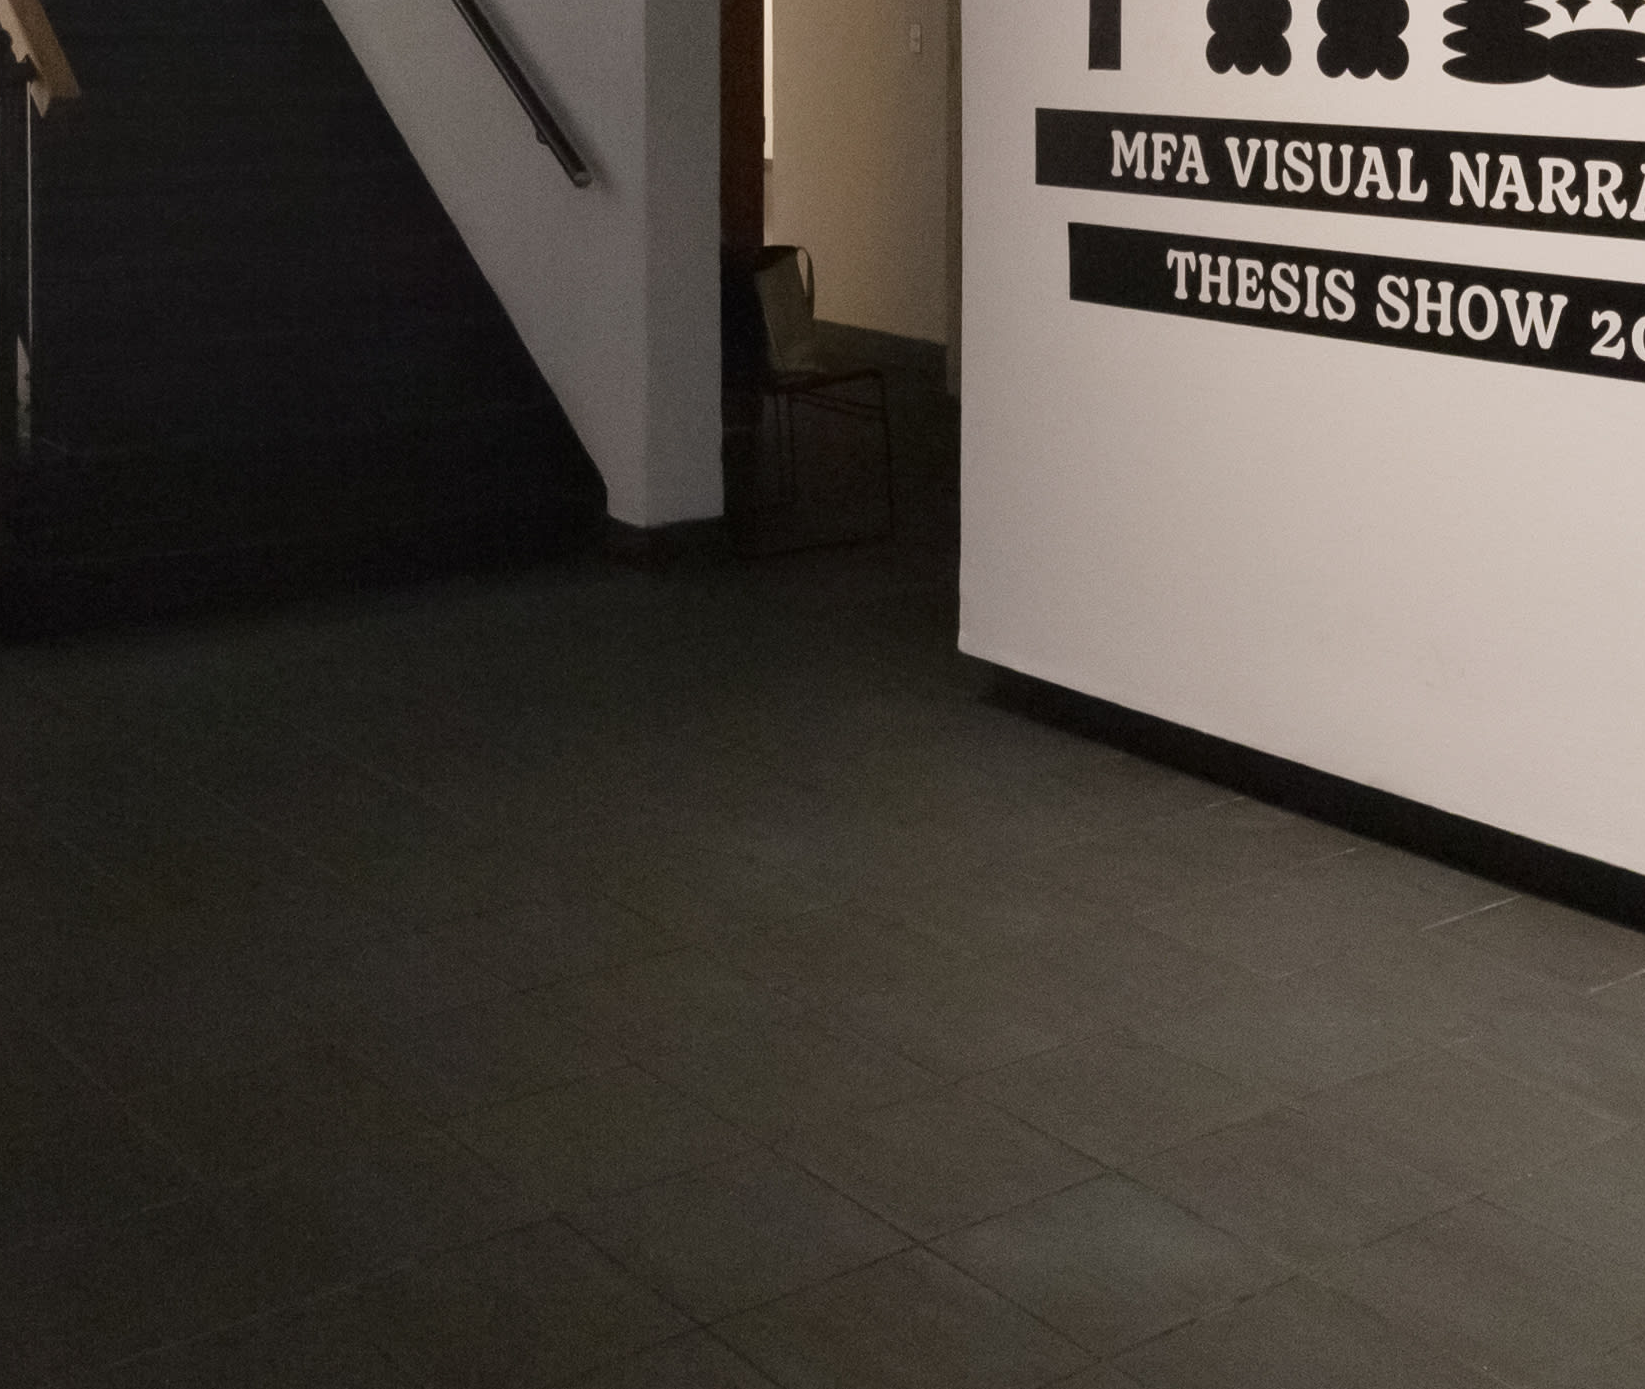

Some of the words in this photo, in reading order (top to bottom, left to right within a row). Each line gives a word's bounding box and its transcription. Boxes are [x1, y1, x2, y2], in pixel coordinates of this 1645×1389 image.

[1109, 128, 1211, 186] MFA
[1225, 136, 1429, 204] VISUAL
[1166, 248, 1357, 323] THESIS
[1375, 274, 1569, 351] SHOW
